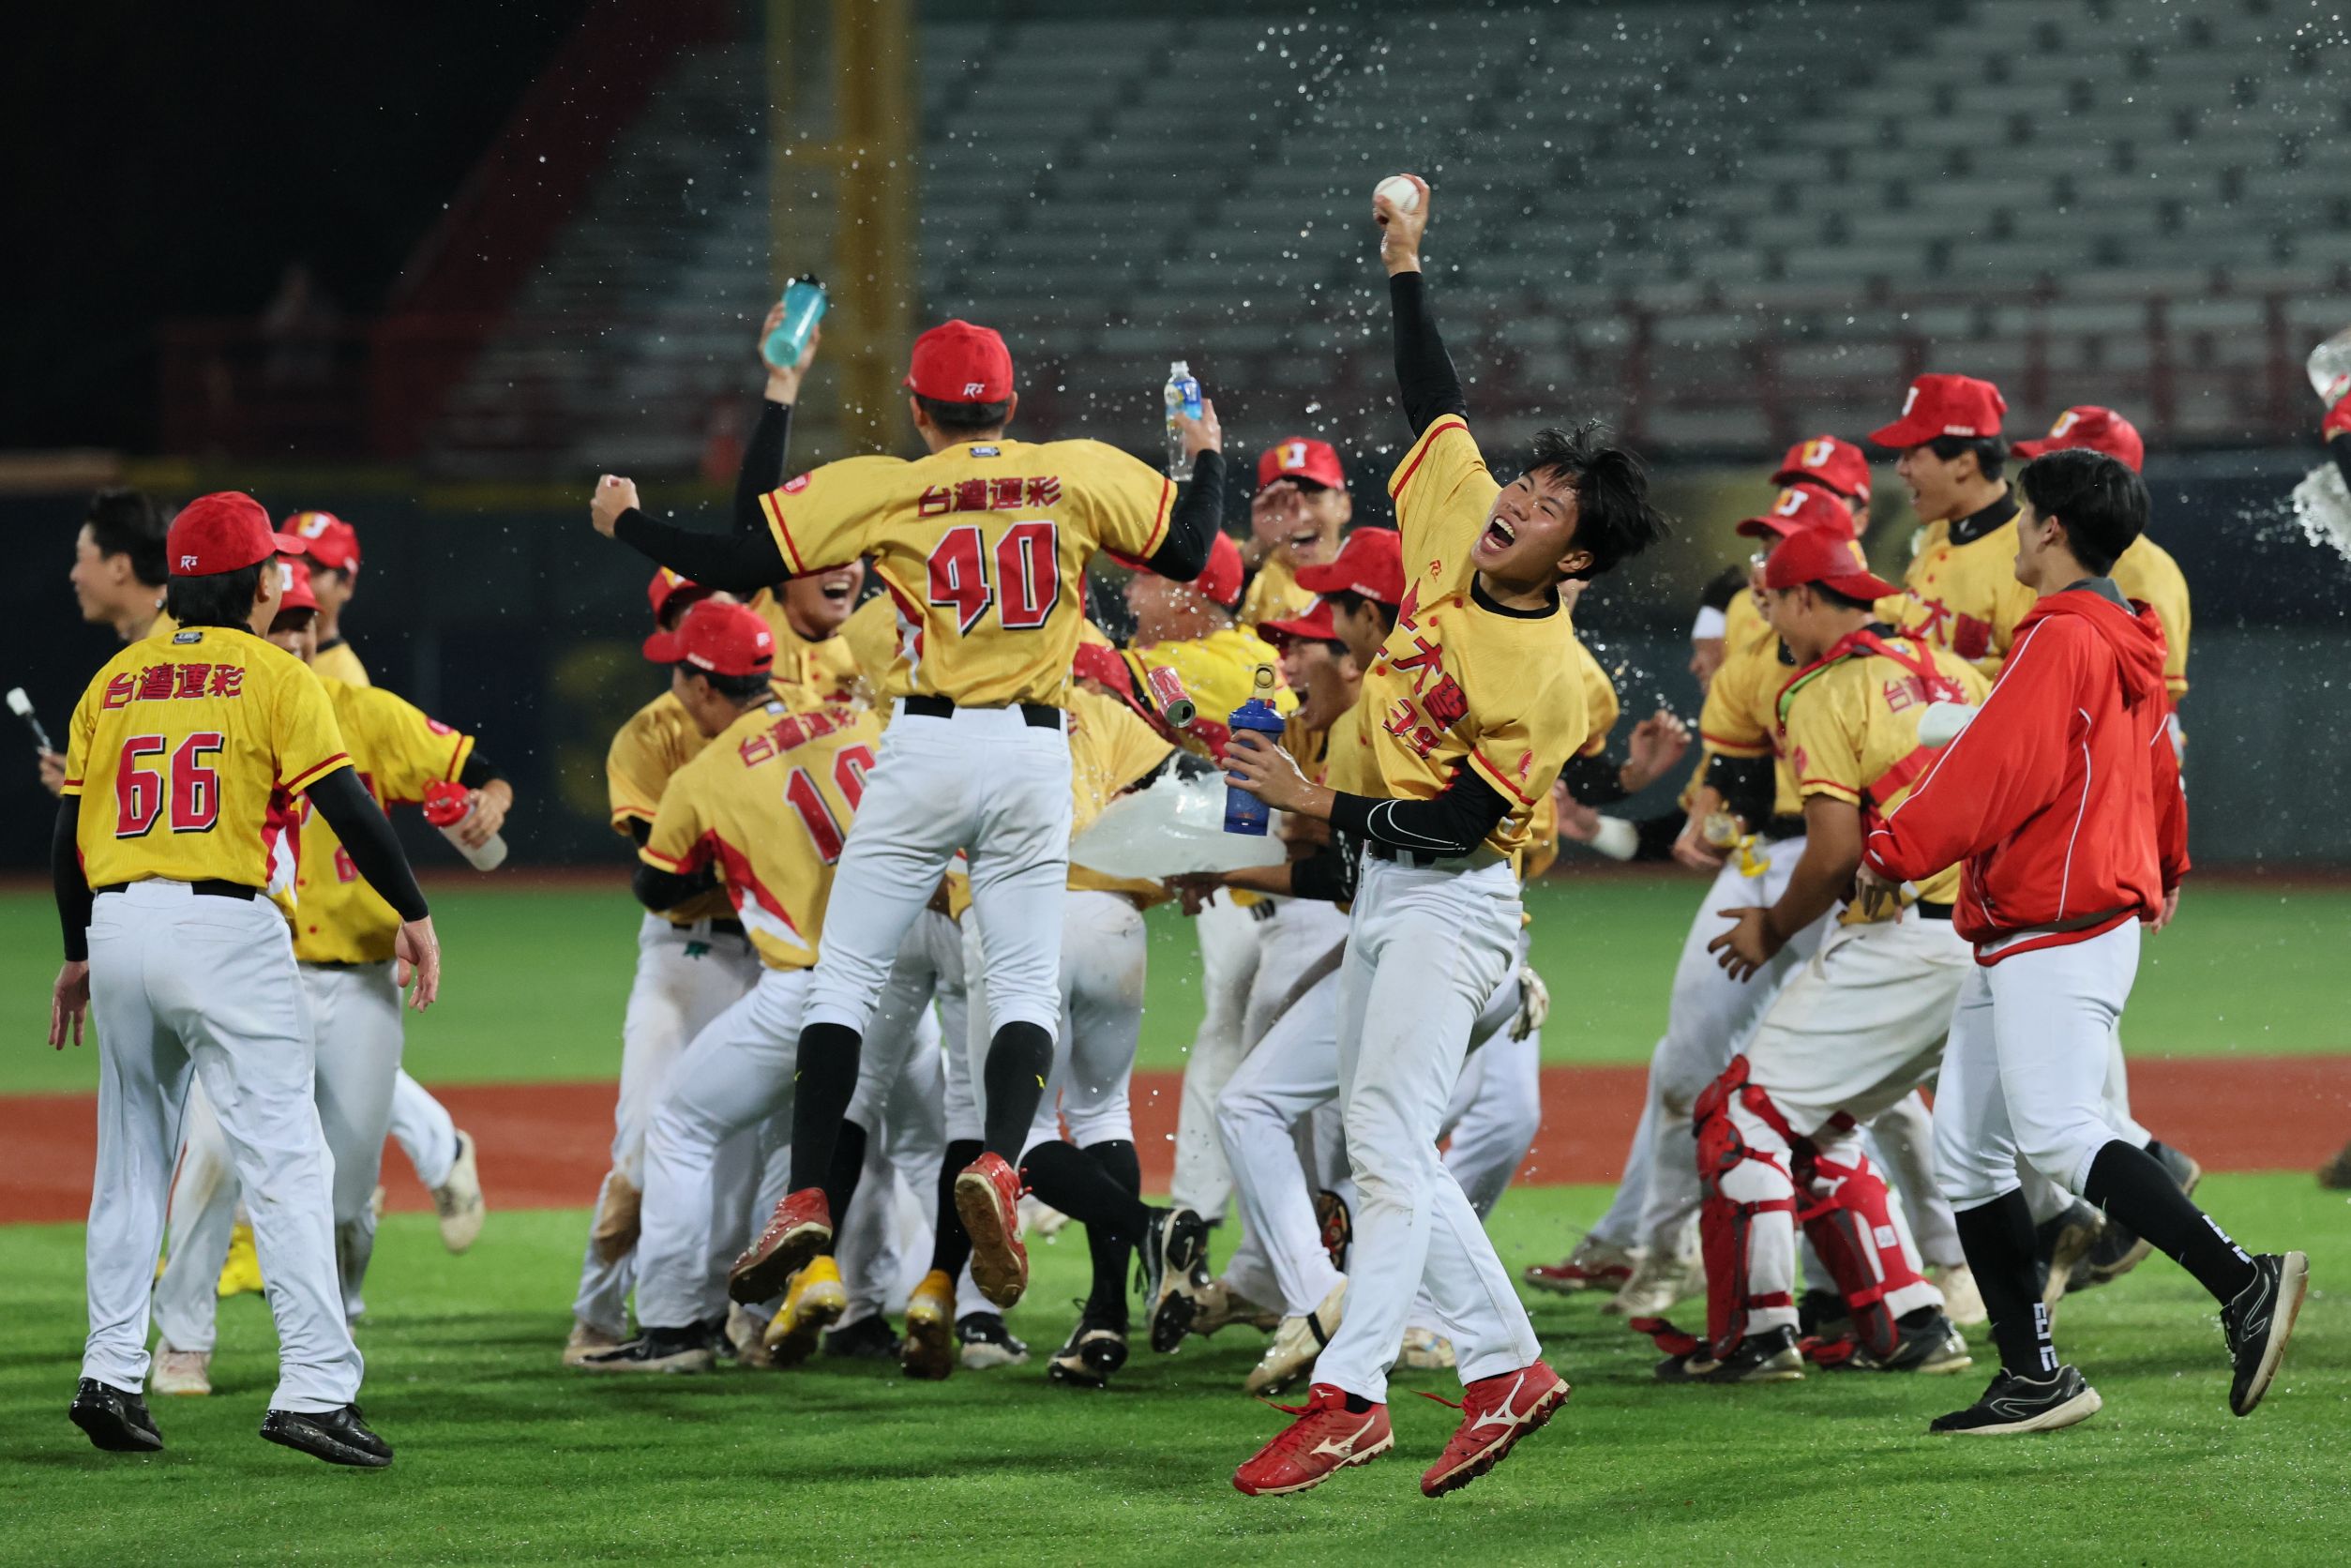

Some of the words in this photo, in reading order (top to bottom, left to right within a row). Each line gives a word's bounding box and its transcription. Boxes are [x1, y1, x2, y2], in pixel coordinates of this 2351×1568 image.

[918, 475, 1062, 517] 台灣運彩
[927, 520, 1061, 638] 40
[102, 662, 246, 711] 台灣運彩
[114, 731, 224, 839] 66
